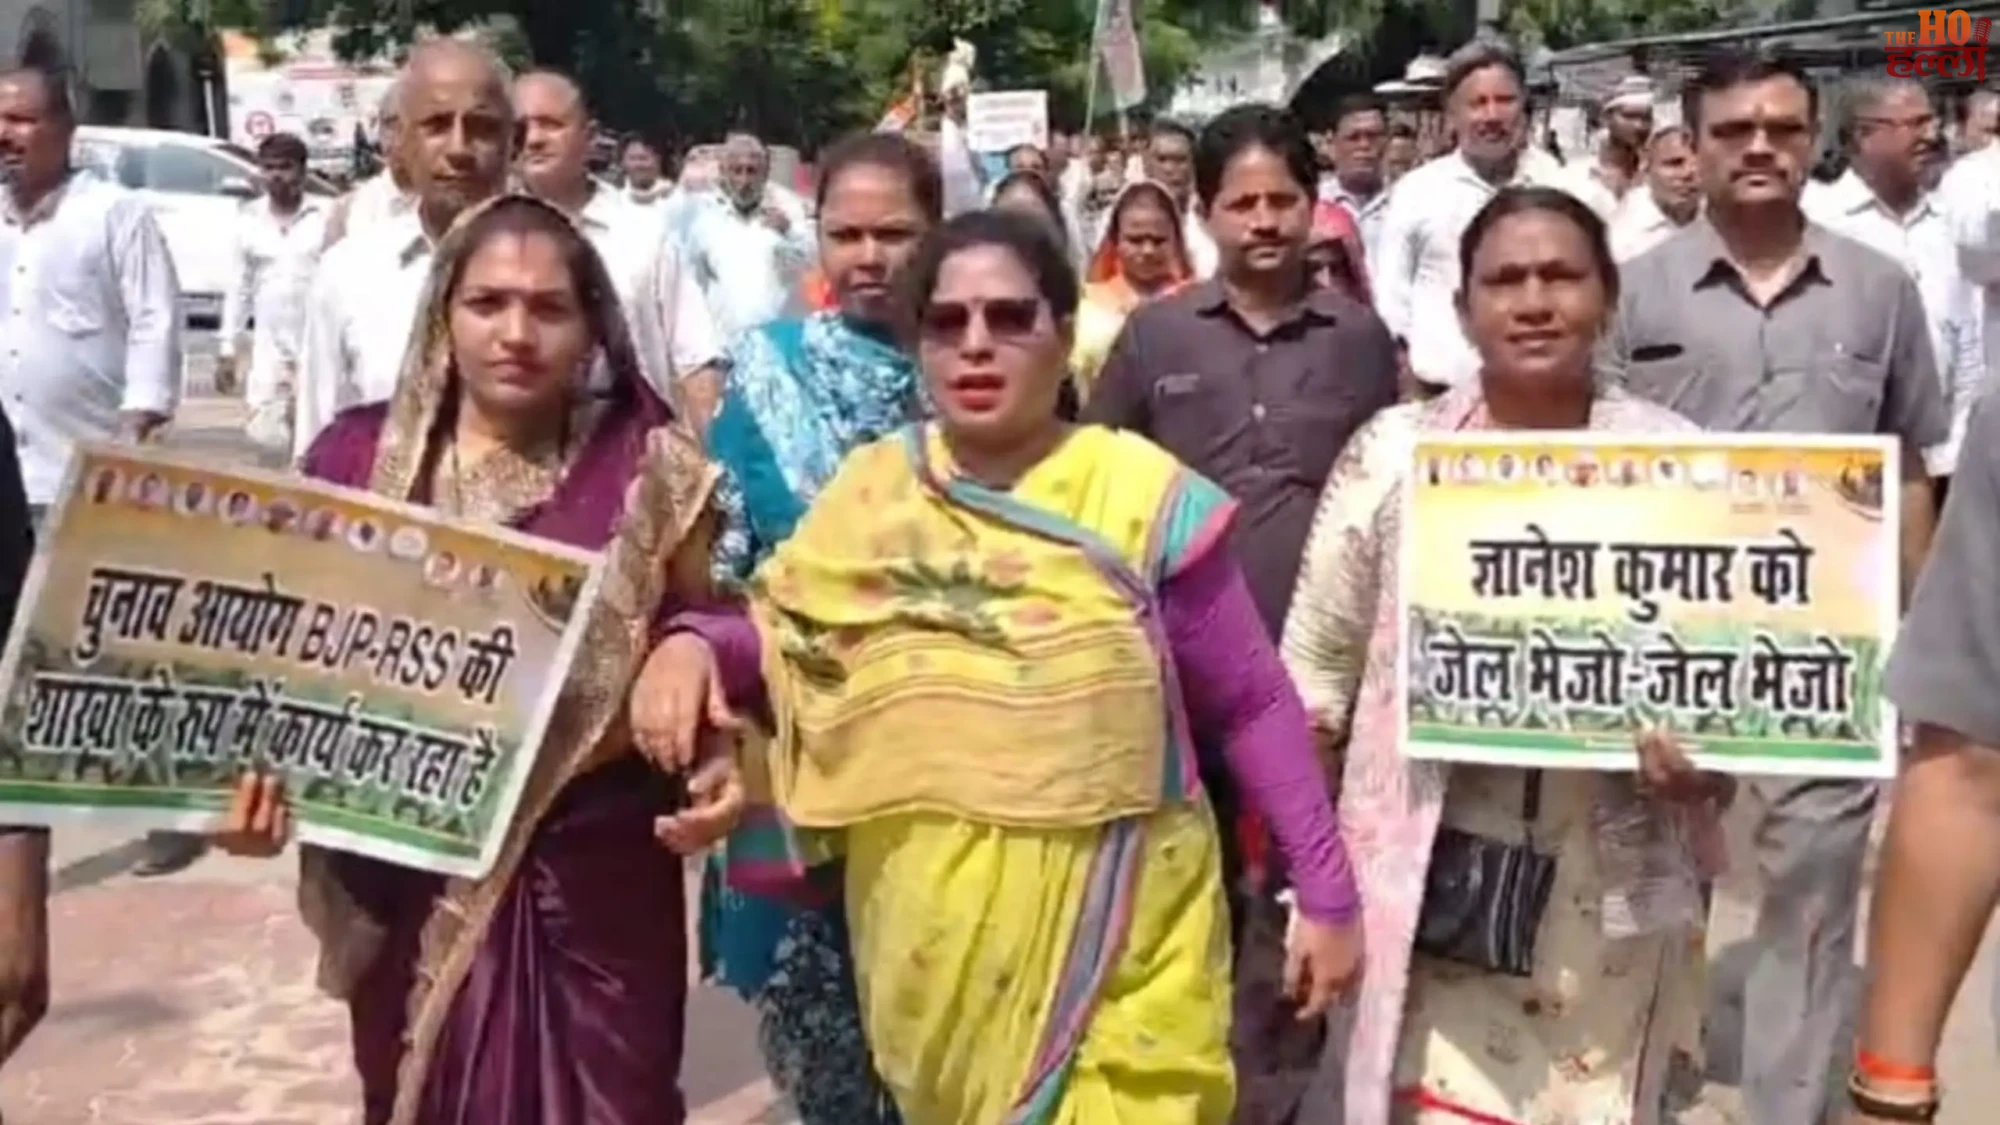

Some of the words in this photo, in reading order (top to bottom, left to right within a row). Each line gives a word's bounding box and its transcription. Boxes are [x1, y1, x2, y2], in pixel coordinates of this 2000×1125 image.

[1469, 523, 1600, 598] ज्ञानेश
[1609, 541, 1738, 622] कुमार
[1747, 529, 1814, 605] को
[76, 568, 185, 660] चुनाव
[179, 572, 305, 656] आयोग
[298, 603, 456, 690] BJP-RSS
[457, 626, 515, 704] की
[1430, 627, 1515, 701] जेल
[1751, 635, 1851, 712] भेजो
[26, 678, 135, 748] शाखा
[132, 668, 177, 751] के
[233, 680, 282, 758] में
[268, 696, 357, 771] कार्य
[349, 719, 410, 783] कर
[406, 734, 469, 800] रहा
[460, 728, 496, 804] है
